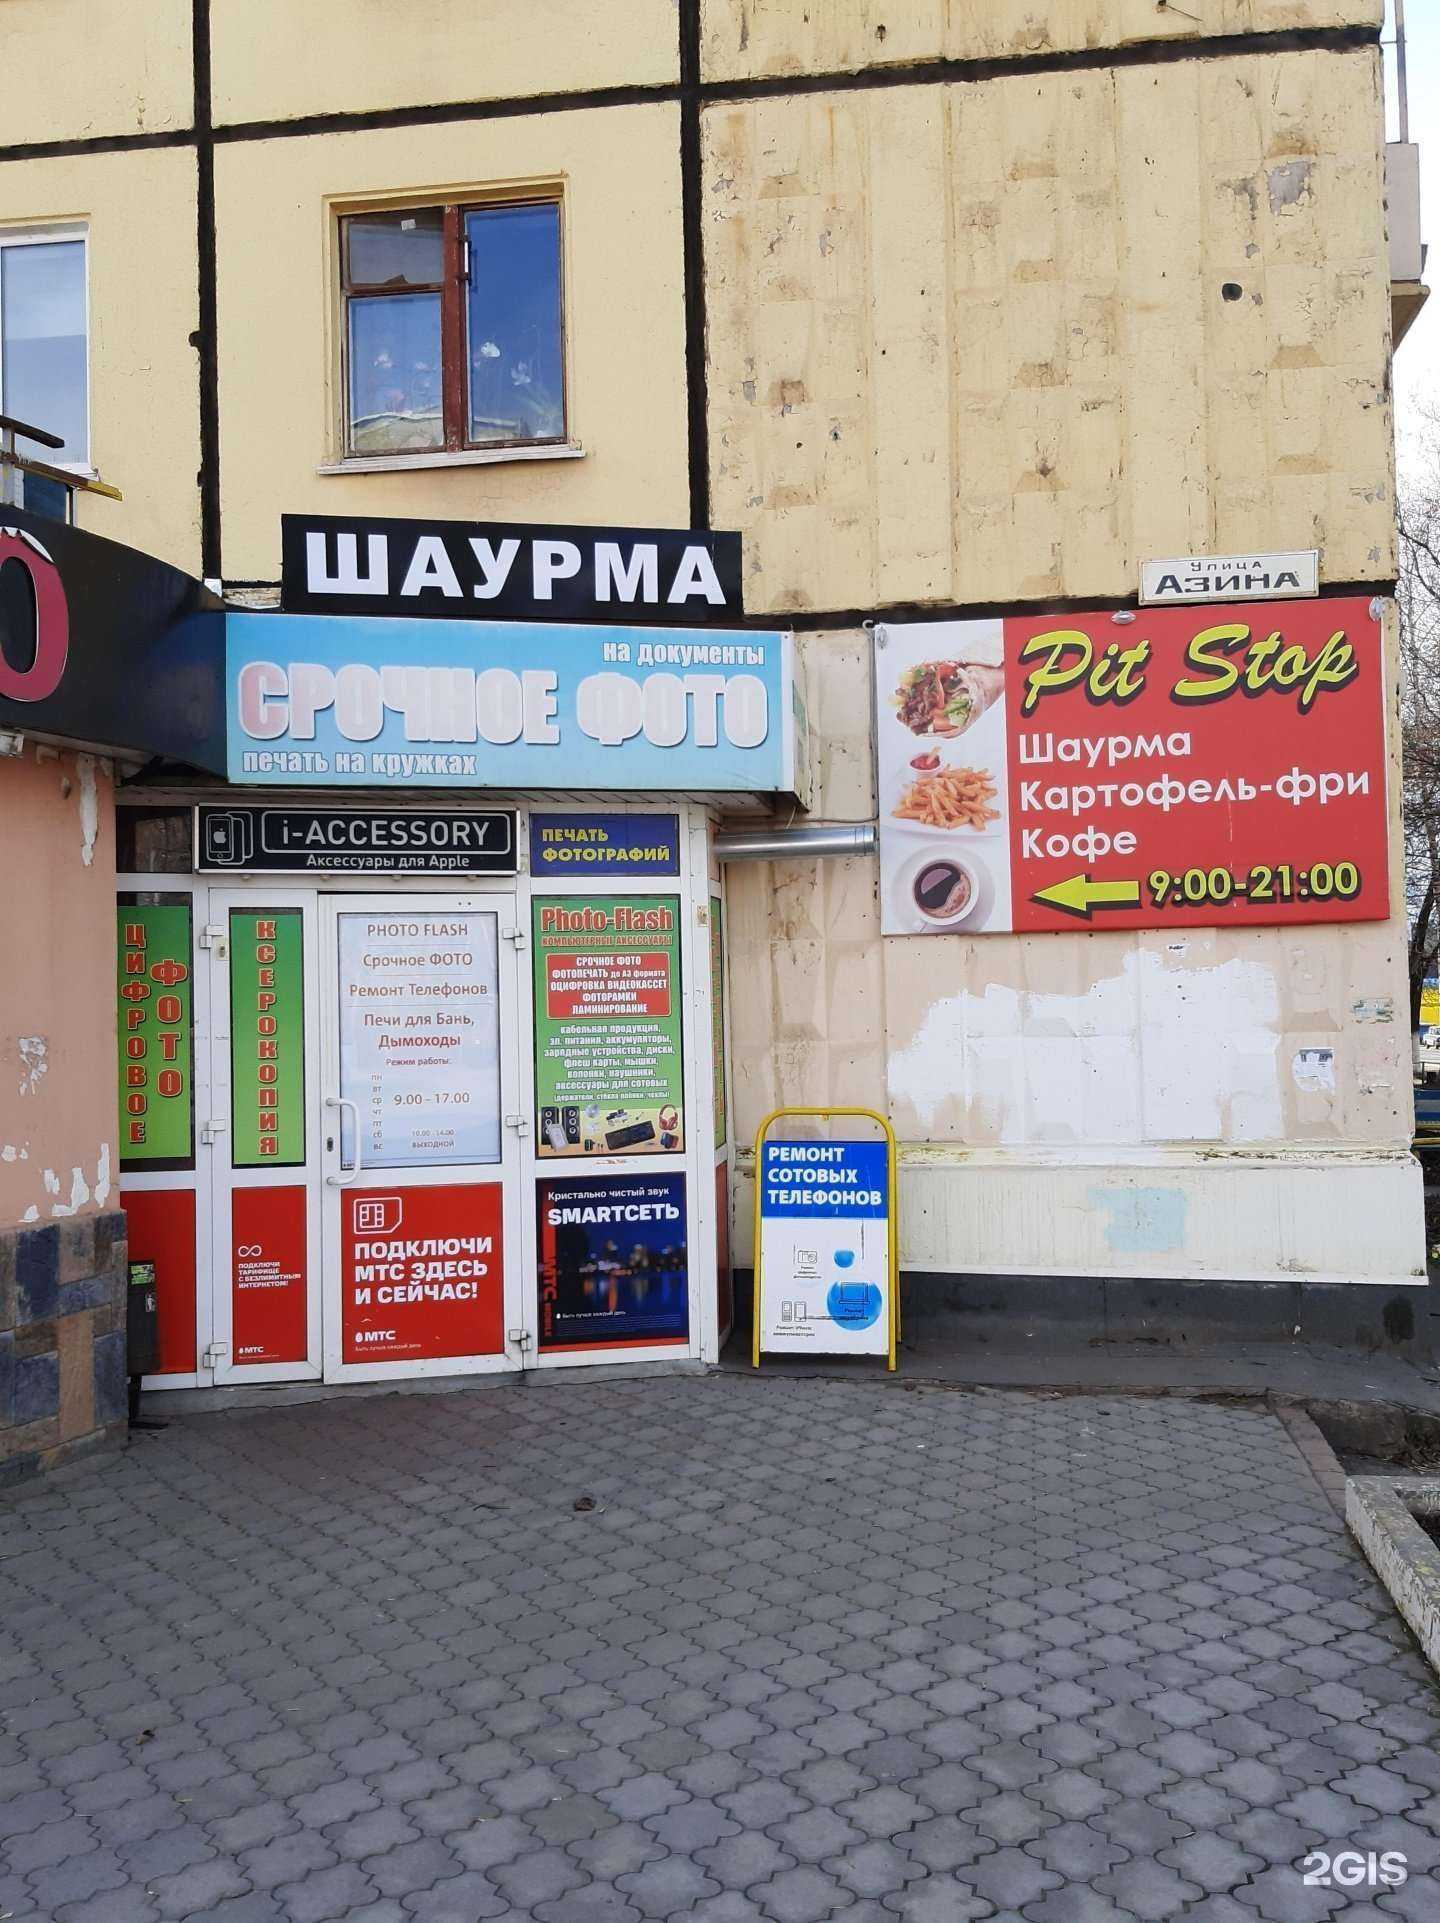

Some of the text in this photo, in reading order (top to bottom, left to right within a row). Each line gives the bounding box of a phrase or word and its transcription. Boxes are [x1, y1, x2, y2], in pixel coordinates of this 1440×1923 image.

[305, 531, 727, 606] ШАУРМА
[1155, 571, 1300, 595] АЗИНА
[602, 641, 766, 668] на документы
[1019, 622, 1360, 713] Pit Stop
[237, 660, 769, 748] СРОЧНОЕ ФОТО
[1018, 731, 1192, 768] Шаурма
[242, 750, 477, 779] печать на кружках
[1019, 767, 1371, 816] Картофель-фри
[282, 819, 491, 848] i-ACCESSORY
[541, 827, 610, 843] ПЕЧАТЬ
[541, 843, 671, 862] ФОТОГРАФИЙ
[1021, 825, 1138, 863] Кофе
[306, 854, 470, 870] Аксессуары для Apple
[1147, 861, 1361, 906] 9:00-21:00
[540, 905, 674, 932] Photo-Flash
[367, 923, 468, 937] PHOTO FLASH
[363, 953, 473, 970] Срочное ФОТО
[576, 956, 642, 967] СРОЧНОЕ ФОТО
[552, 968, 609, 979] ФОТОПЕЧАТЬ
[350, 982, 488, 998] Ремонт Телефонов
[550, 979, 667, 993] ОЦИФРОВКА ВИДЕОКАССЕТ
[582, 991, 637, 1002] ФОТОРАМКИ
[572, 1003, 648, 1015] ЛАМИНИРОВАНИЕ
[150, 959, 188, 1098] ФОТО
[364, 1013, 474, 1028] Печи для Бань,
[121, 923, 151, 1144] ЦИФРОВОЕ
[256, 920, 278, 1156] КСЕРОКОПИЯ
[378, 1034, 461, 1050] Дымоходы
[768, 1146, 845, 1162] РЕМОНТ
[768, 1167, 858, 1183] СОТОВЫХ
[609, 1187, 645, 1198] чистый
[647, 1187, 669, 1197] звук
[768, 1189, 882, 1206] ТЕЛЕФОНОВ
[354, 1236, 492, 1261] ПОДКЛЮЧИ
[238, 1261, 281, 1270] ПОДКЛЮЧИ
[355, 1260, 488, 1282] МТС ЗДЕСЬ
[355, 1280, 478, 1305] И СЕЙЧАС!
[364, 1330, 396, 1342] МТС
[244, 1346, 264, 1354] МТС
